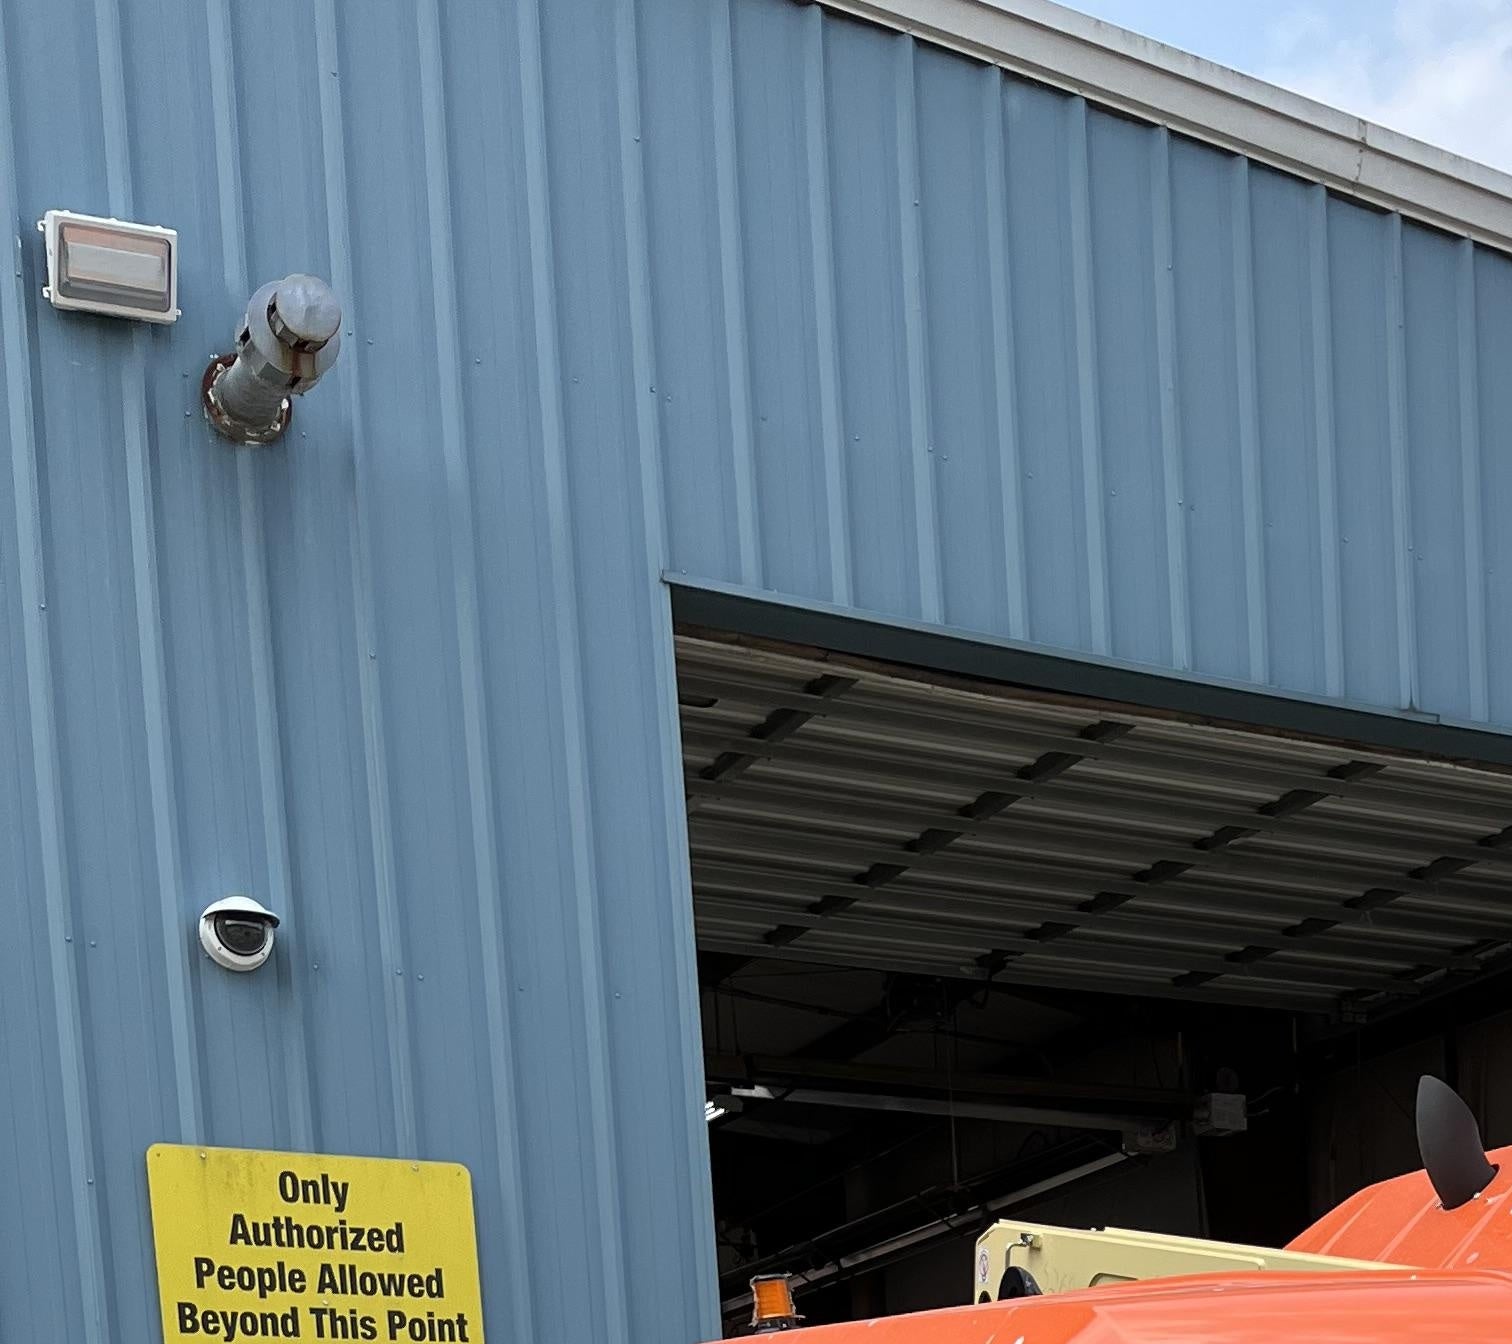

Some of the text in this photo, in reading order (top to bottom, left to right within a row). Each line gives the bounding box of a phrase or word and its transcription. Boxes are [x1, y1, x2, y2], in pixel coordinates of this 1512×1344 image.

[278, 1171, 349, 1213] Only
[229, 1214, 405, 1253] Authorized
[194, 1257, 444, 1299] People Allowed
[177, 1302, 469, 1343] Beyond This Point
